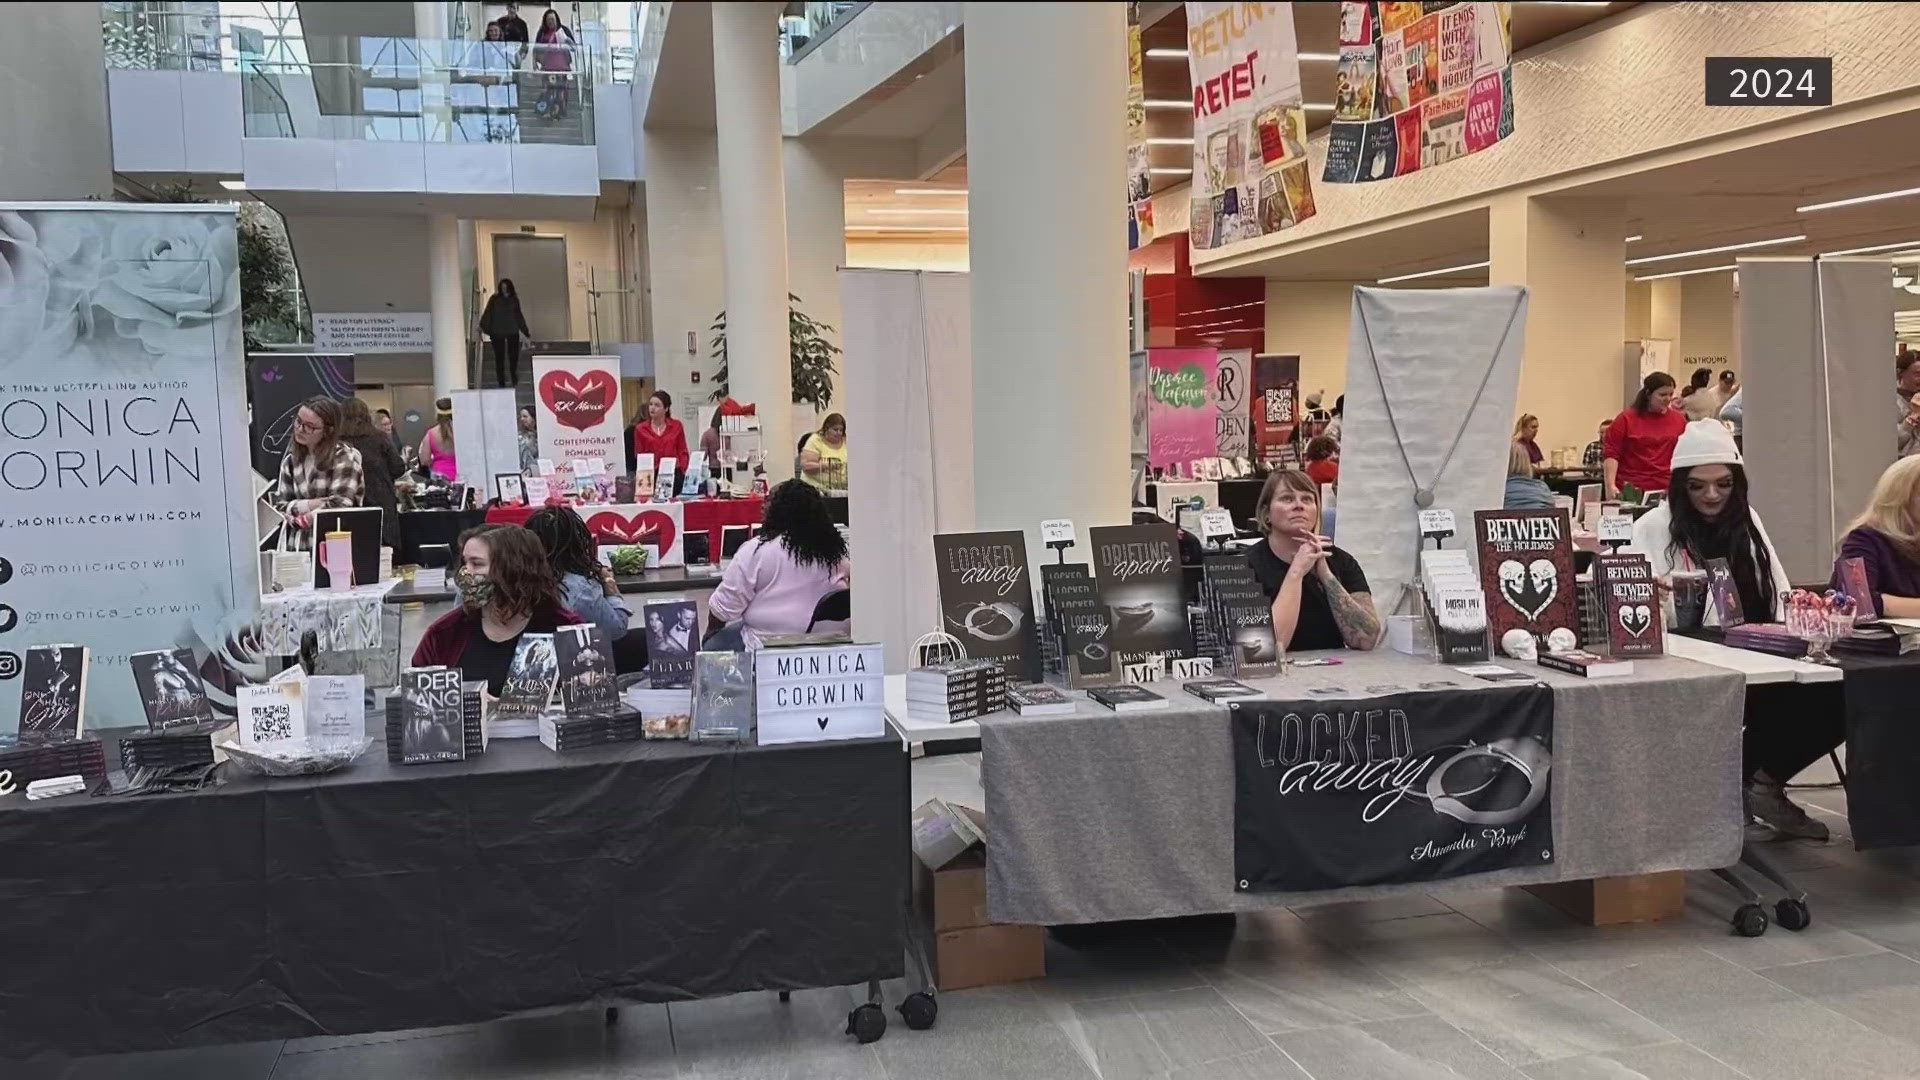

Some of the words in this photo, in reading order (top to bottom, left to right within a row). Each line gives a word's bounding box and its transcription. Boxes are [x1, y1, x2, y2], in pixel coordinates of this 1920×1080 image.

[1442, 15, 1451, 31] IT
[1442, 26, 1466, 46] WITH
[1442, 46, 1455, 62] US
[1442, 68, 1473, 88] HOOVER
[1684, 356, 1727, 364] RESTROOMS
[143, 381, 189, 390] AUTHOR
[553, 436, 616, 447] CONTEMPORARY
[1485, 517, 1560, 543] BETWEEN
[1101, 541, 1171, 567] DRIFTING
[1495, 541, 1512, 552] THE
[1513, 539, 1555, 551] HOLIDAYS
[20, 558, 186, 576] @monicacorwin
[948, 544, 1015, 573] LOCKED
[1112, 555, 1173, 582] apart
[1606, 566, 1647, 579] BETWEEN
[960, 563, 1022, 596] away
[1612, 583, 1654, 596] BETWEEN
[25, 603, 201, 624] @monica_corwin
[1070, 613, 1104, 629] LOCKED
[1230, 606, 1269, 620] DRIFTING
[1236, 614, 1270, 628] apart
[777, 653, 865, 676] MONICA
[1130, 664, 1154, 683] Mr
[1178, 661, 1213, 678] Mrs
[417, 671, 460, 691] DER
[416, 689, 460, 708] ANG
[777, 683, 864, 706] CORWIN
[433, 708, 461, 725] ED
[1257, 709, 1413, 768] LOCKED
[1279, 755, 1435, 823] away
[1411, 838, 1478, 861] Amanda
[1481, 824, 1528, 849] Bryk
